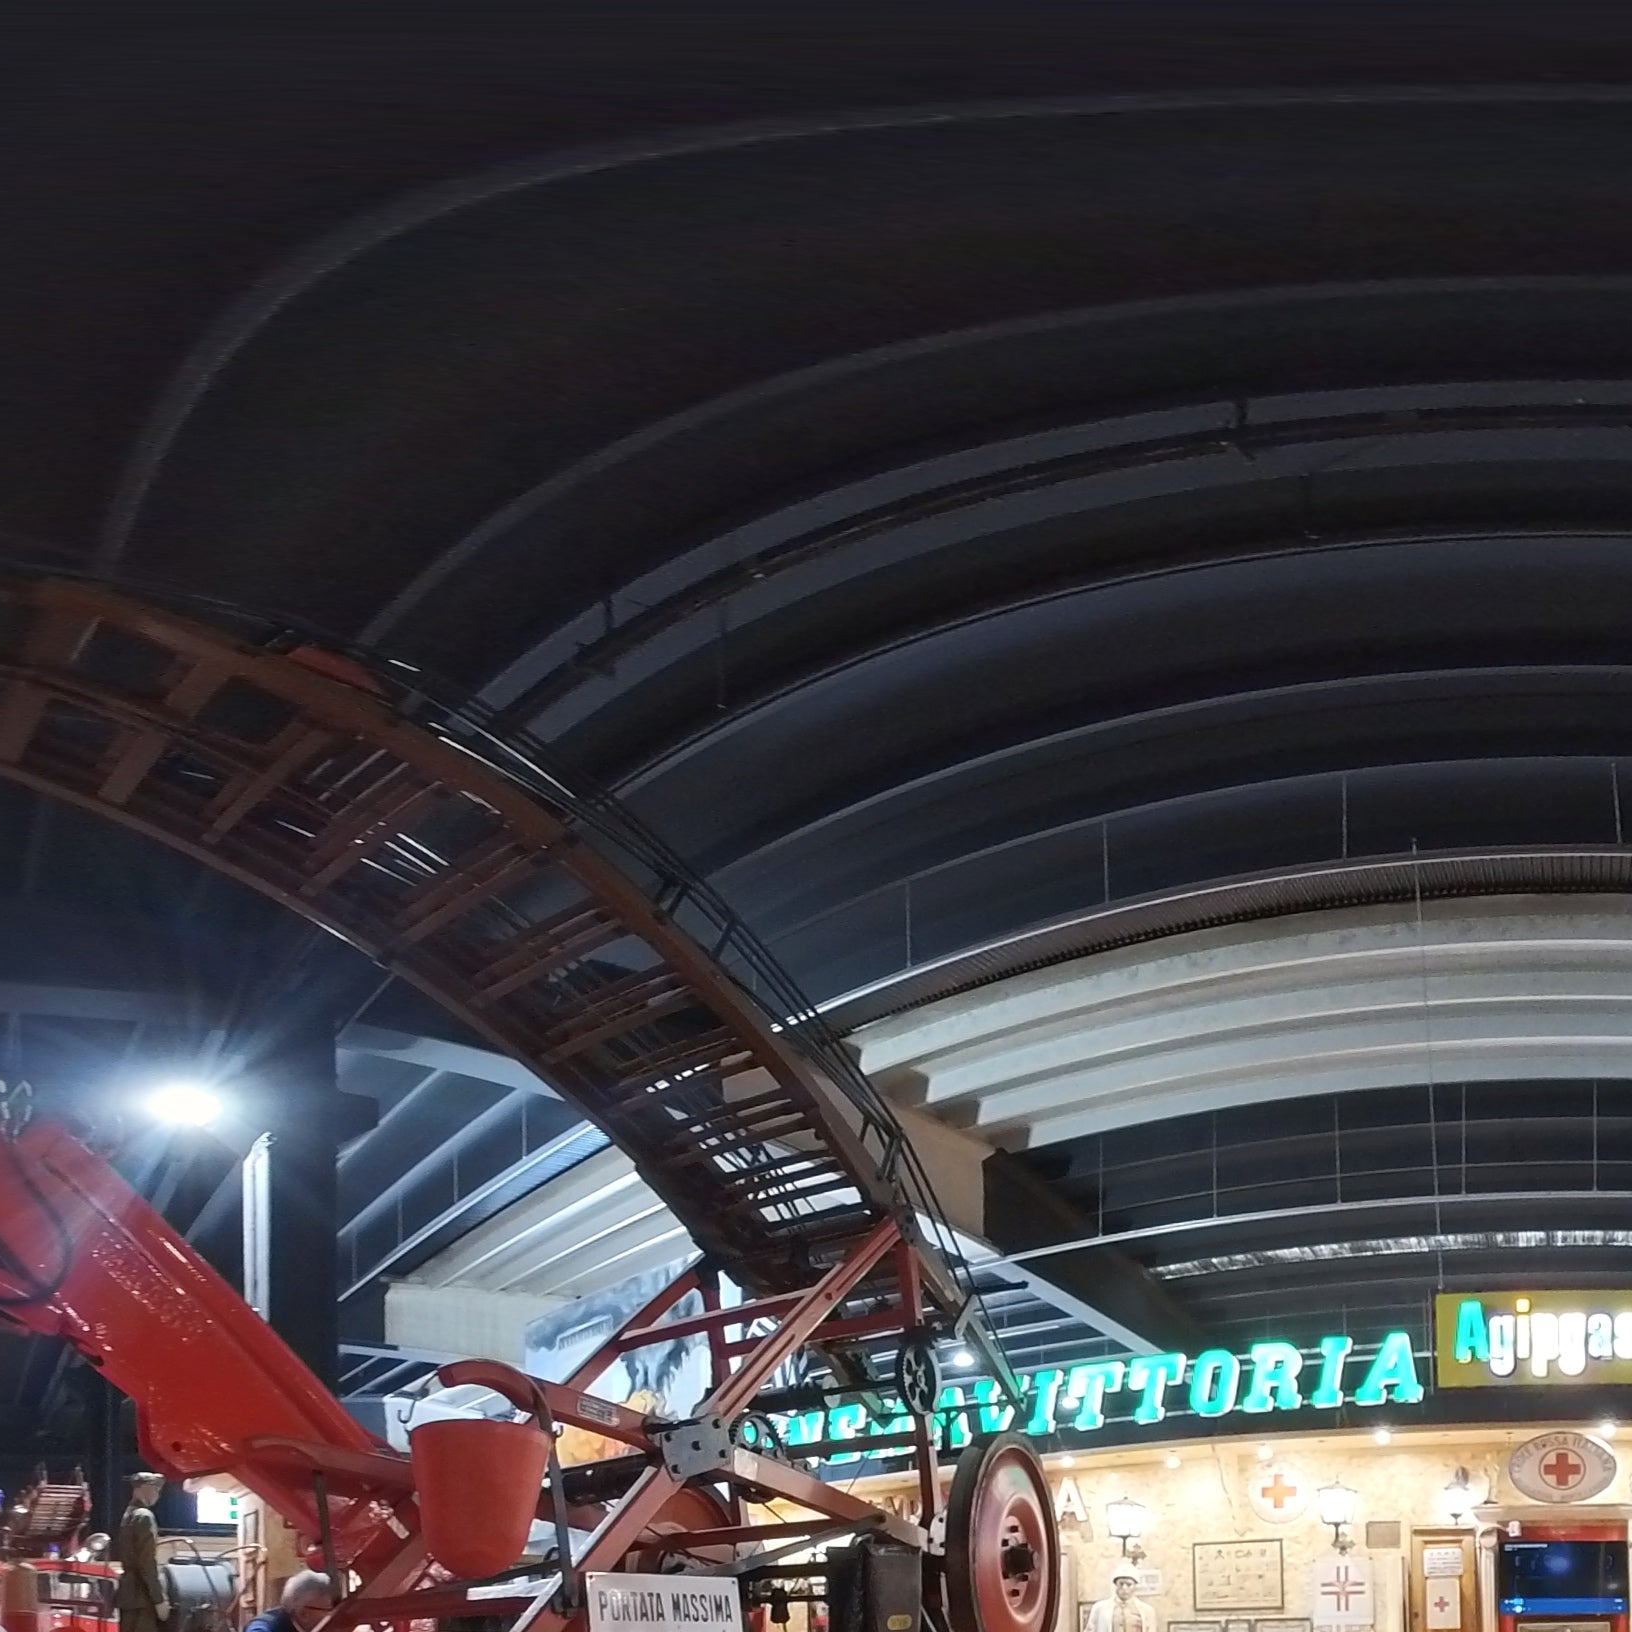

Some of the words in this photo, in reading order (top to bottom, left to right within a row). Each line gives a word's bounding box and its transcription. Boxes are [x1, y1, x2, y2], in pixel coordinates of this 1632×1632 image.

[974, 1332, 1426, 1436] VITTORIA
[598, 1590, 665, 1621] PORTATA
[671, 1593, 733, 1622] MASSIMA
